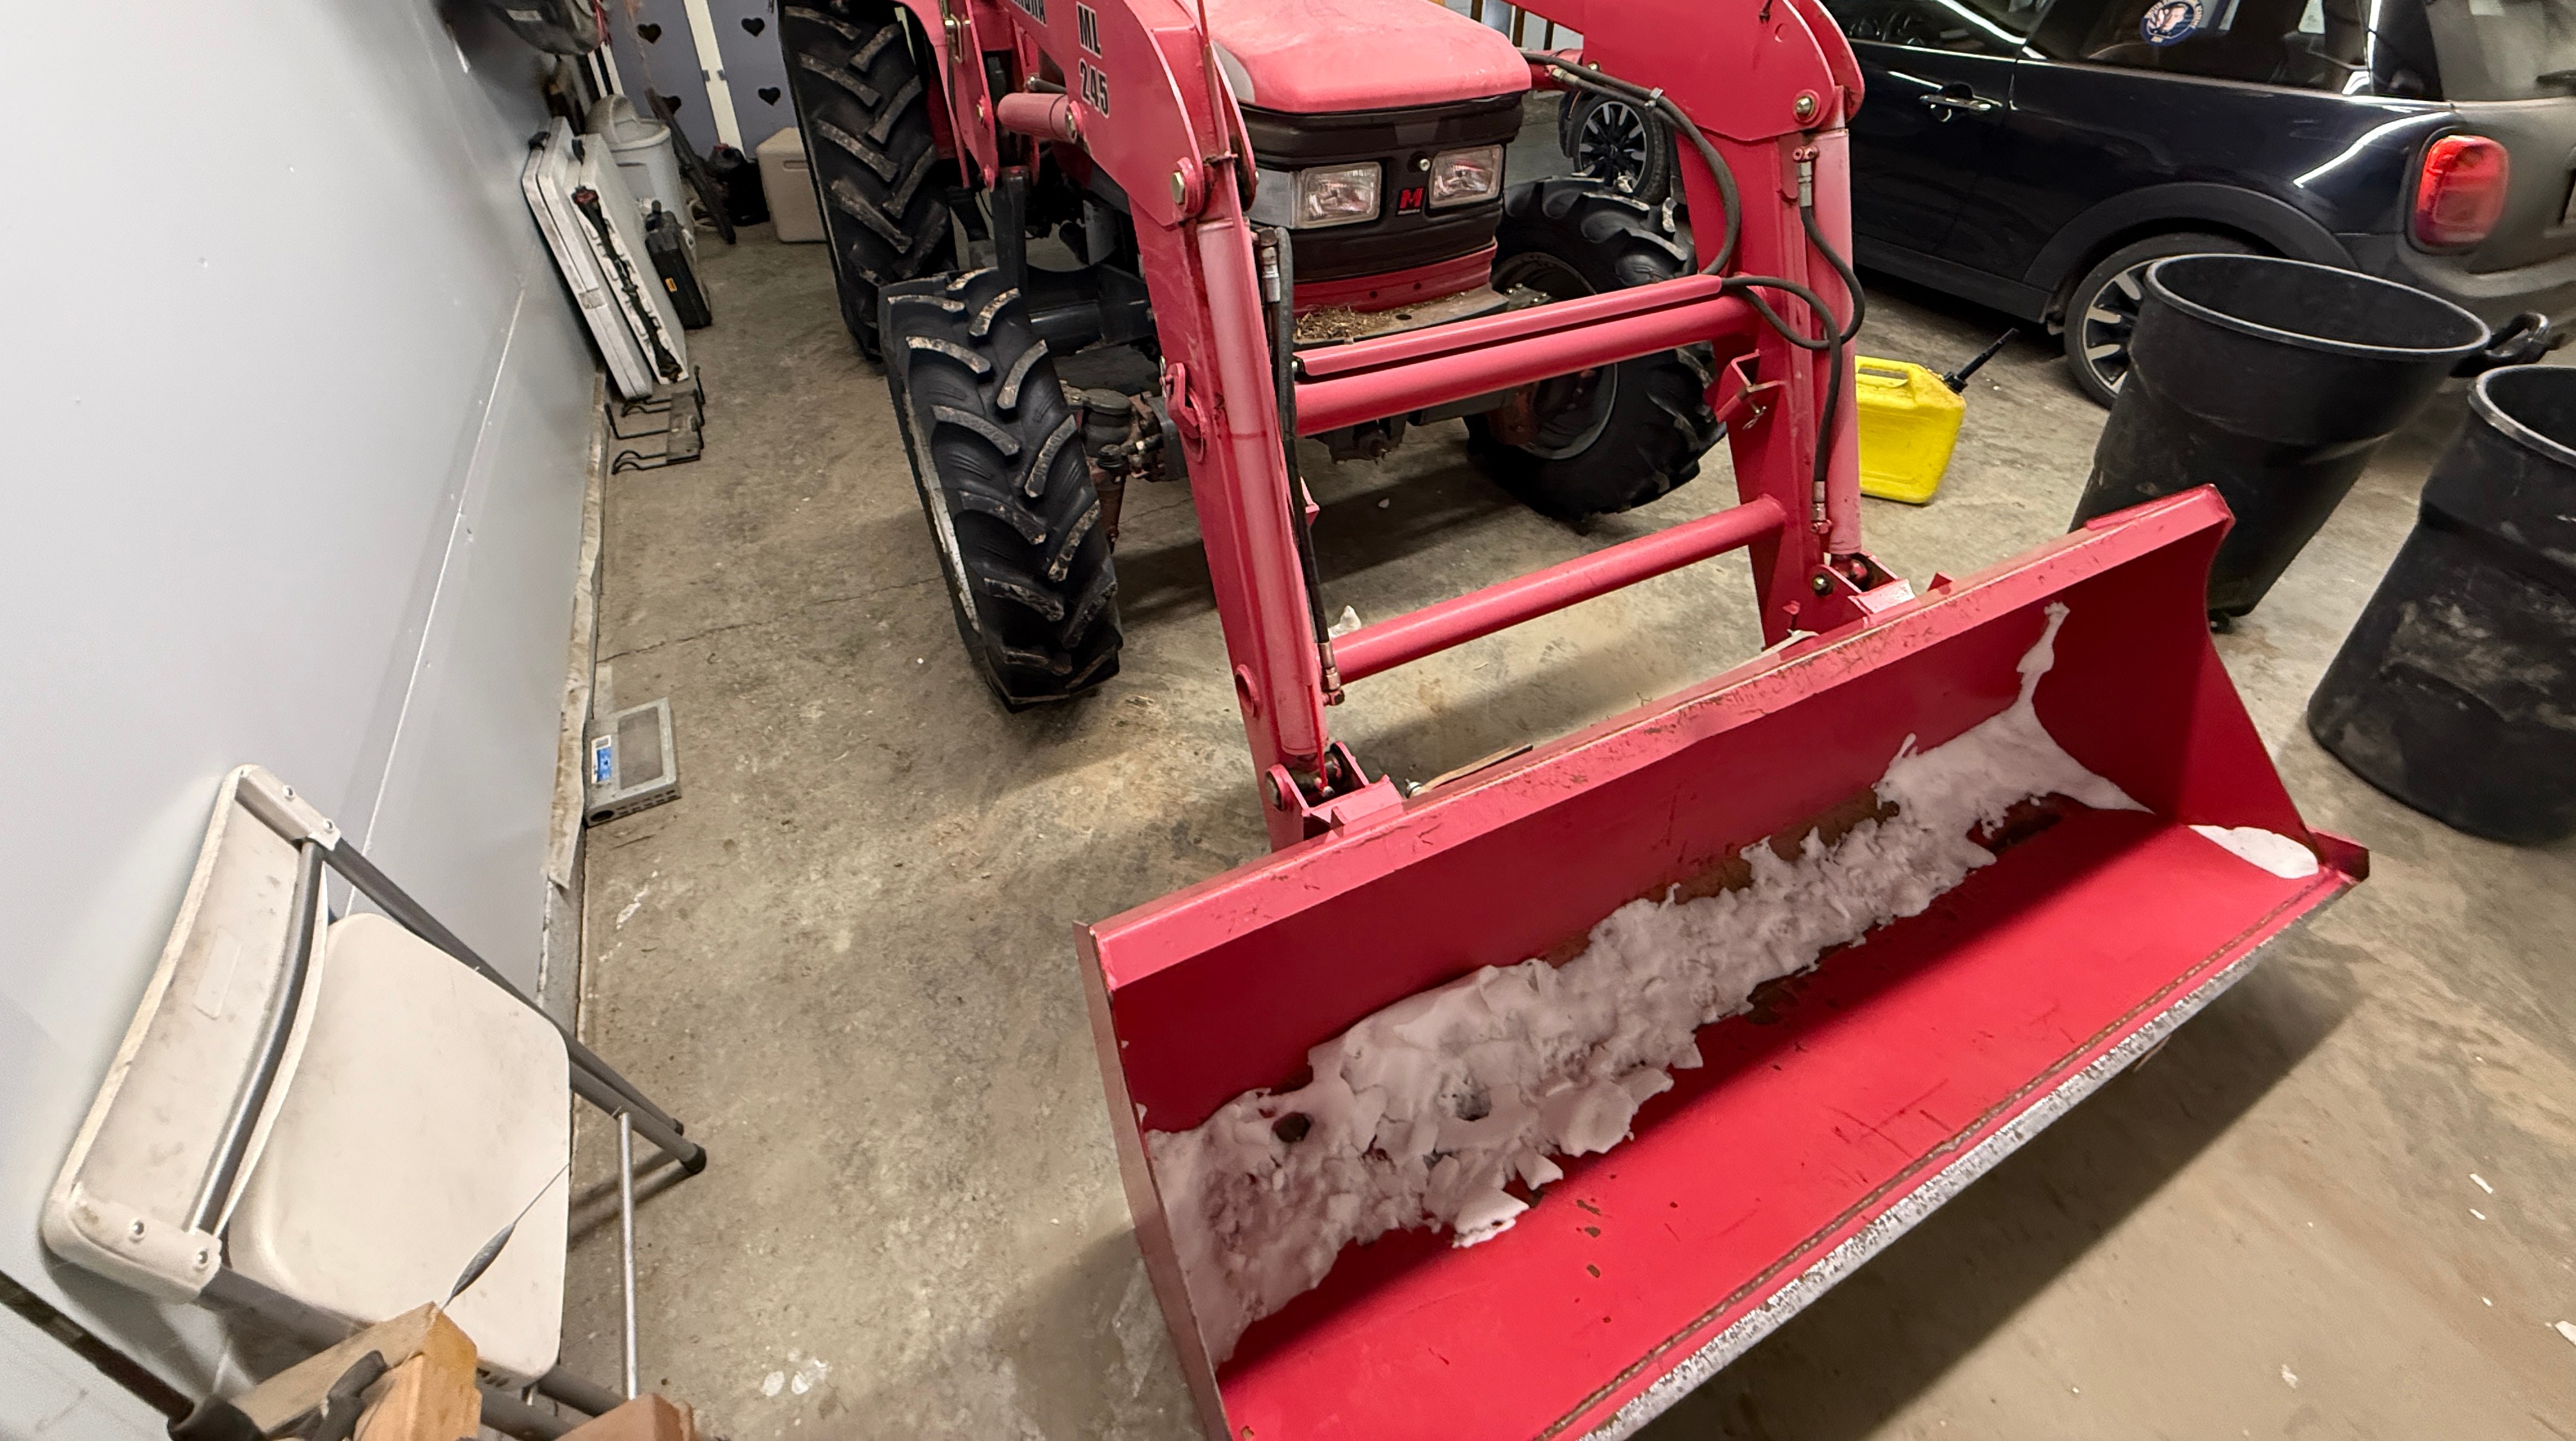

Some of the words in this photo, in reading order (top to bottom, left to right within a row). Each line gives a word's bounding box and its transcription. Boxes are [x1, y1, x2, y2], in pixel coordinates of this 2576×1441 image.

[1077, 3, 1101, 58] ML
[1079, 59, 1109, 117] 245
[1399, 187, 1424, 209] M
